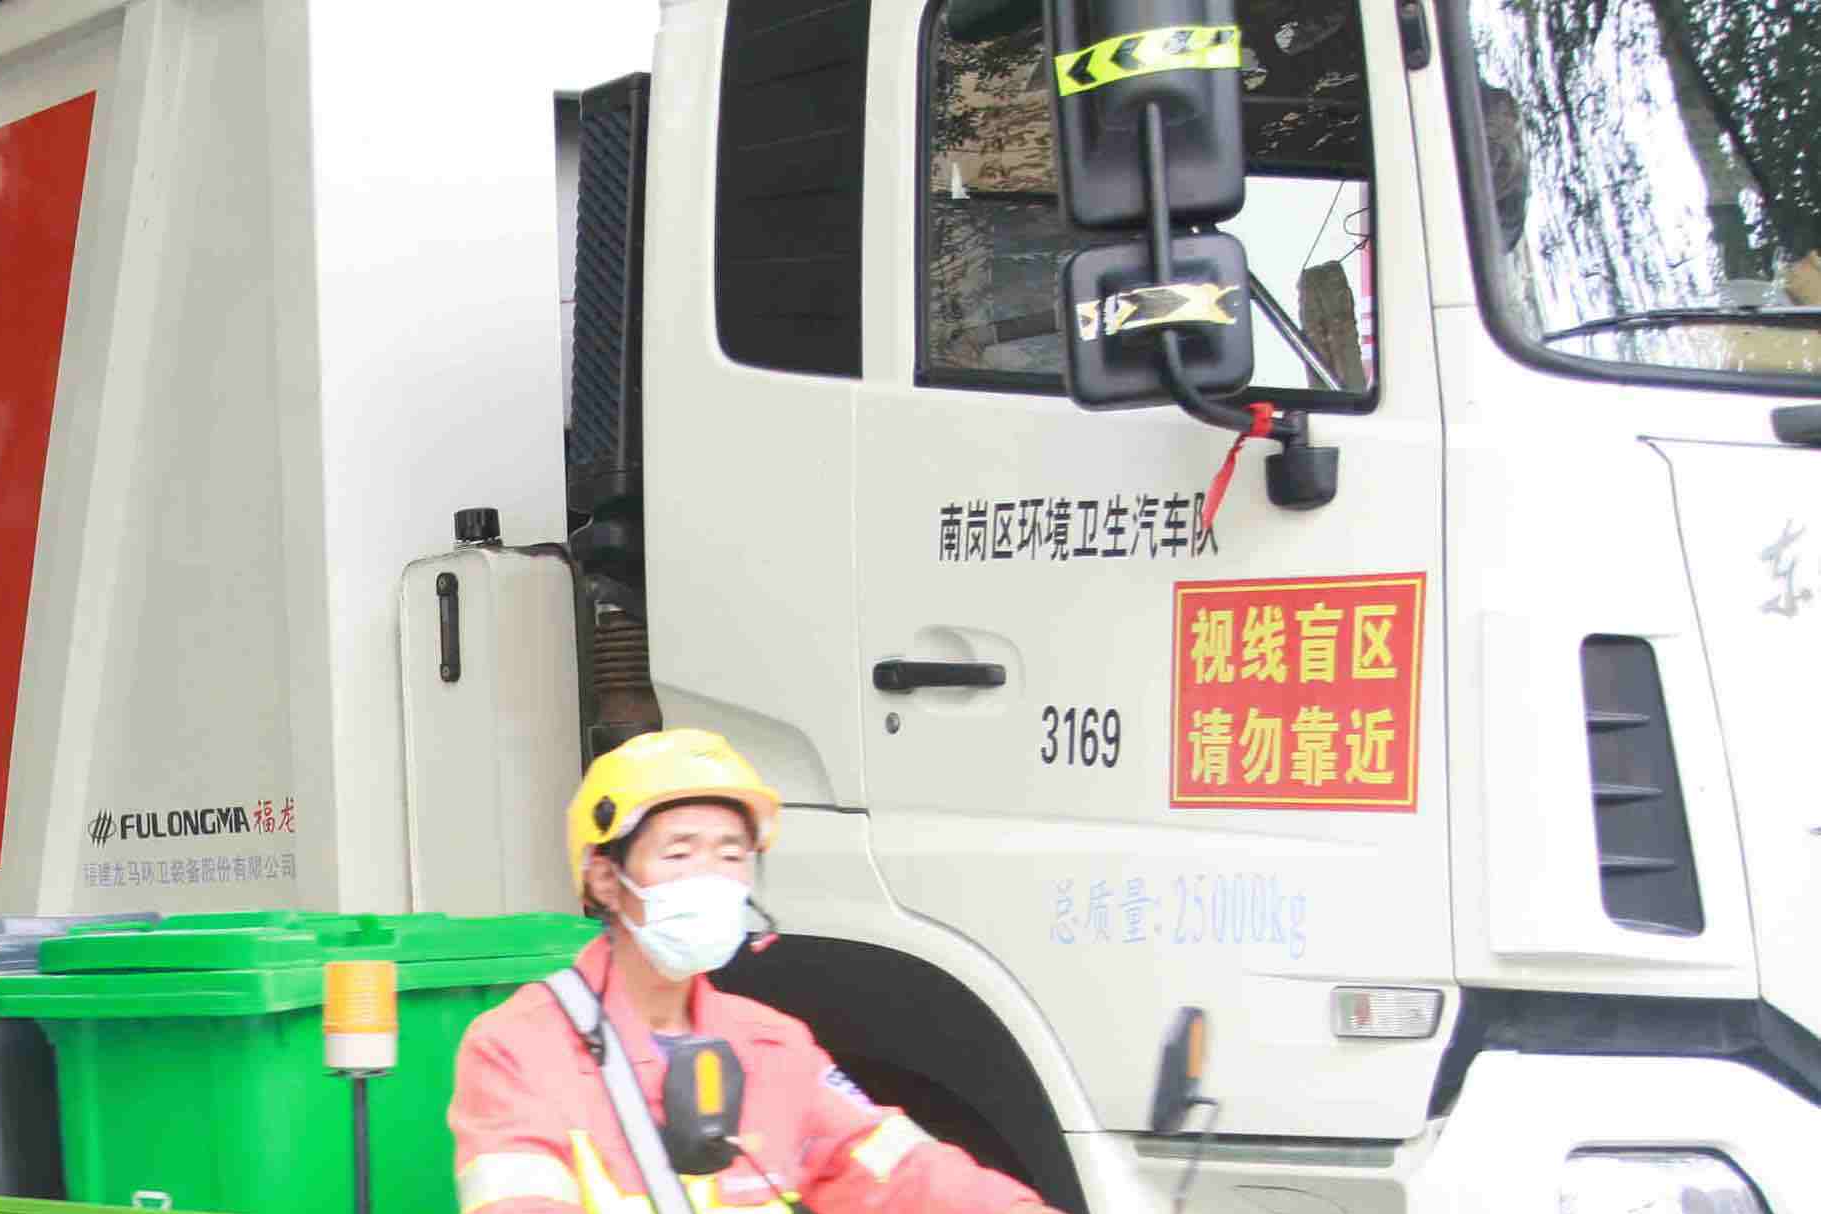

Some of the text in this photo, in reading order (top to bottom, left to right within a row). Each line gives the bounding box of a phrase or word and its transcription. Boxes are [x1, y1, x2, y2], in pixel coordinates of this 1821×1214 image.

[939, 492, 1218, 562] 南岗区环境卫生汽车队
[1190, 601, 1398, 685] 视线盲区
[1040, 704, 1123, 768] 3169
[1188, 704, 1395, 787] 请勿靠近
[120, 806, 251, 841] FULONGMA
